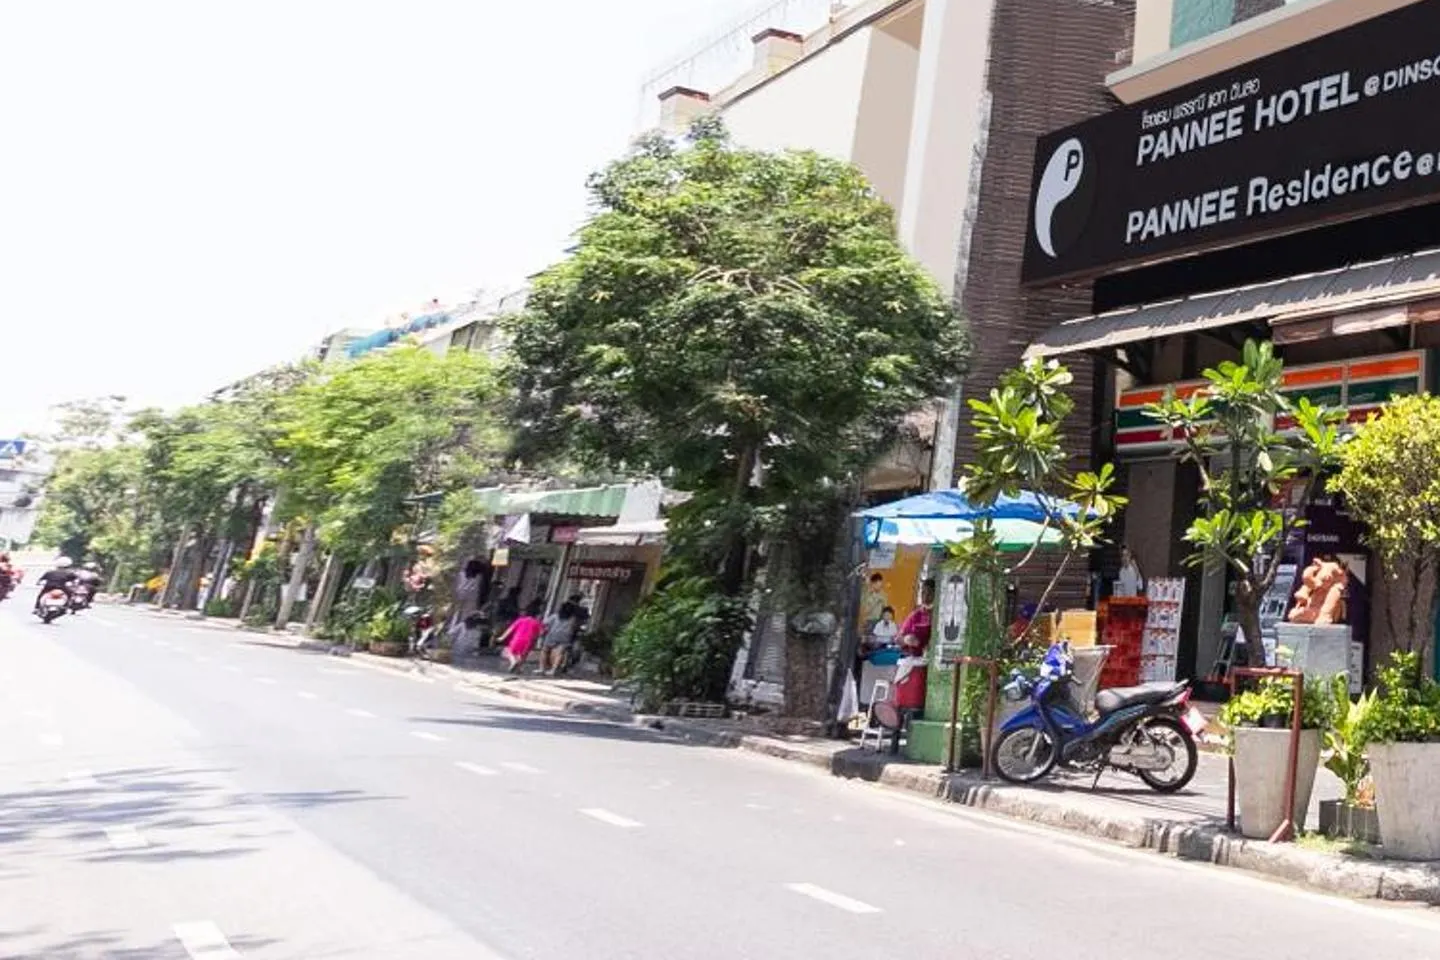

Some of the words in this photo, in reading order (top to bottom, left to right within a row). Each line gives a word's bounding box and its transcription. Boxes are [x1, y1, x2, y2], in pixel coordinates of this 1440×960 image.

[1136, 105, 1245, 166] PANNEE
[1254, 70, 1360, 132] HOTEL
[1125, 186, 1239, 244] PANNEE
